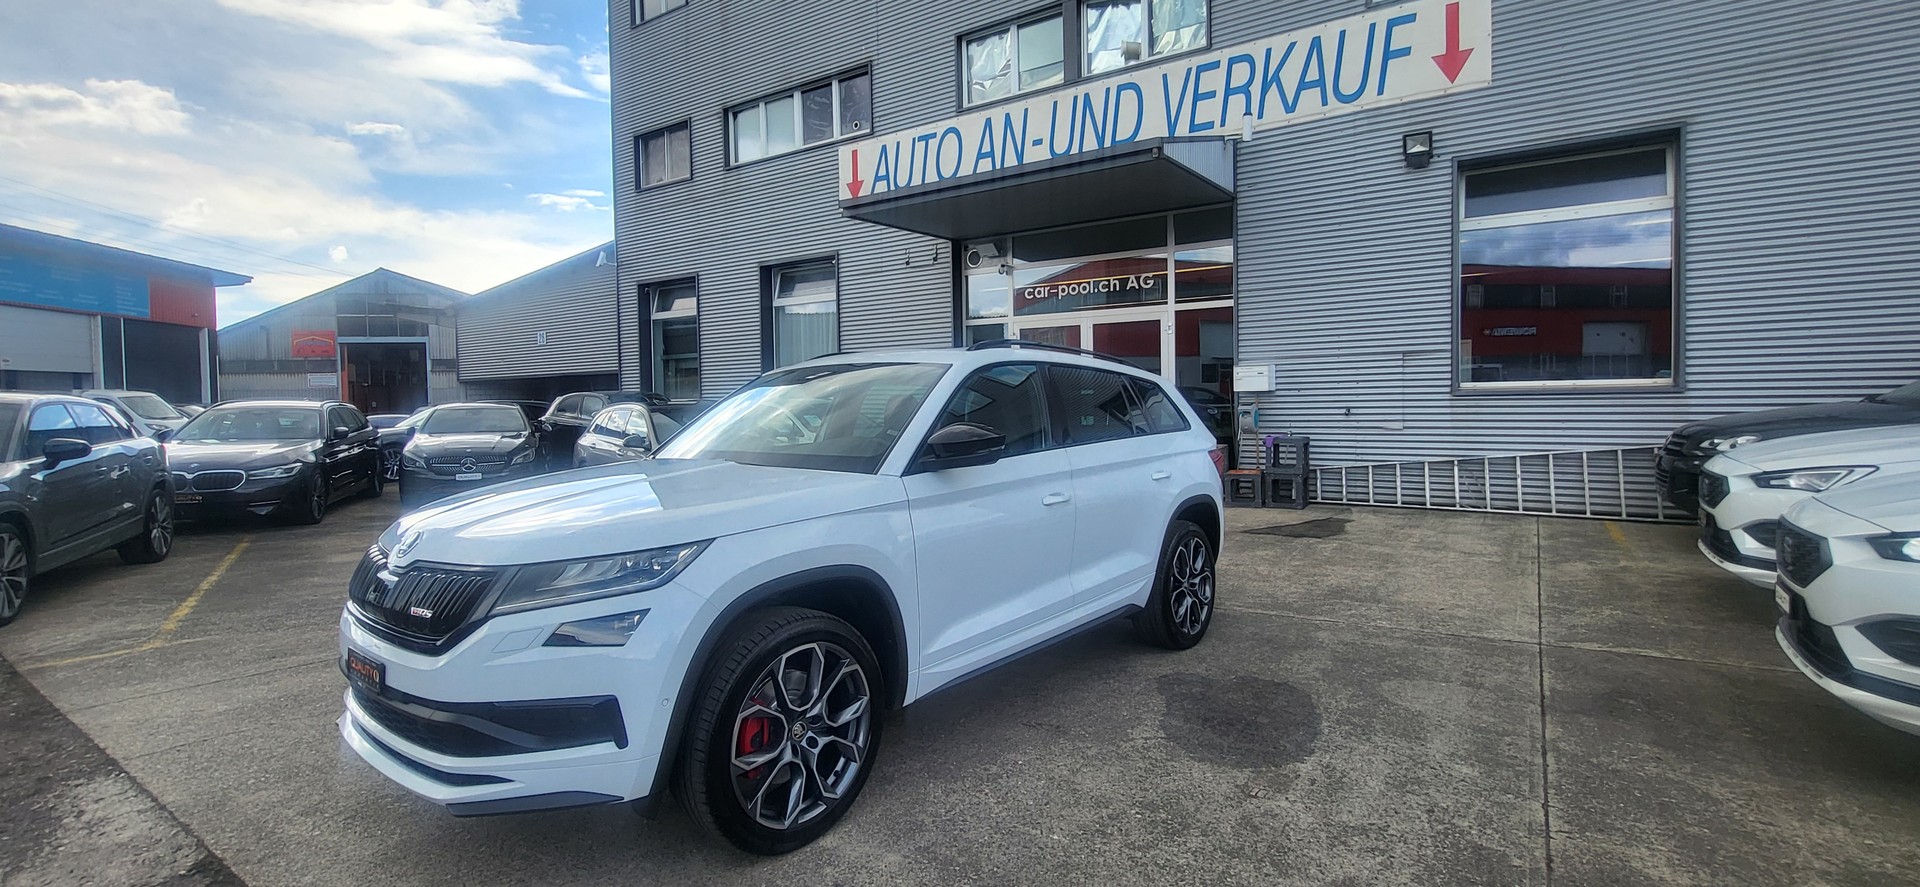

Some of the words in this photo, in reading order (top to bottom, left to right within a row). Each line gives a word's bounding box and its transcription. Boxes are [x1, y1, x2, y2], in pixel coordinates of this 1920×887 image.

[871, 127, 963, 195] AUTO
[972, 81, 1144, 175] AN-UND
[1162, 12, 1417, 138] VERKAUF
[1024, 278, 1120, 299] car-pool.ch
[1126, 273, 1155, 291] AG
